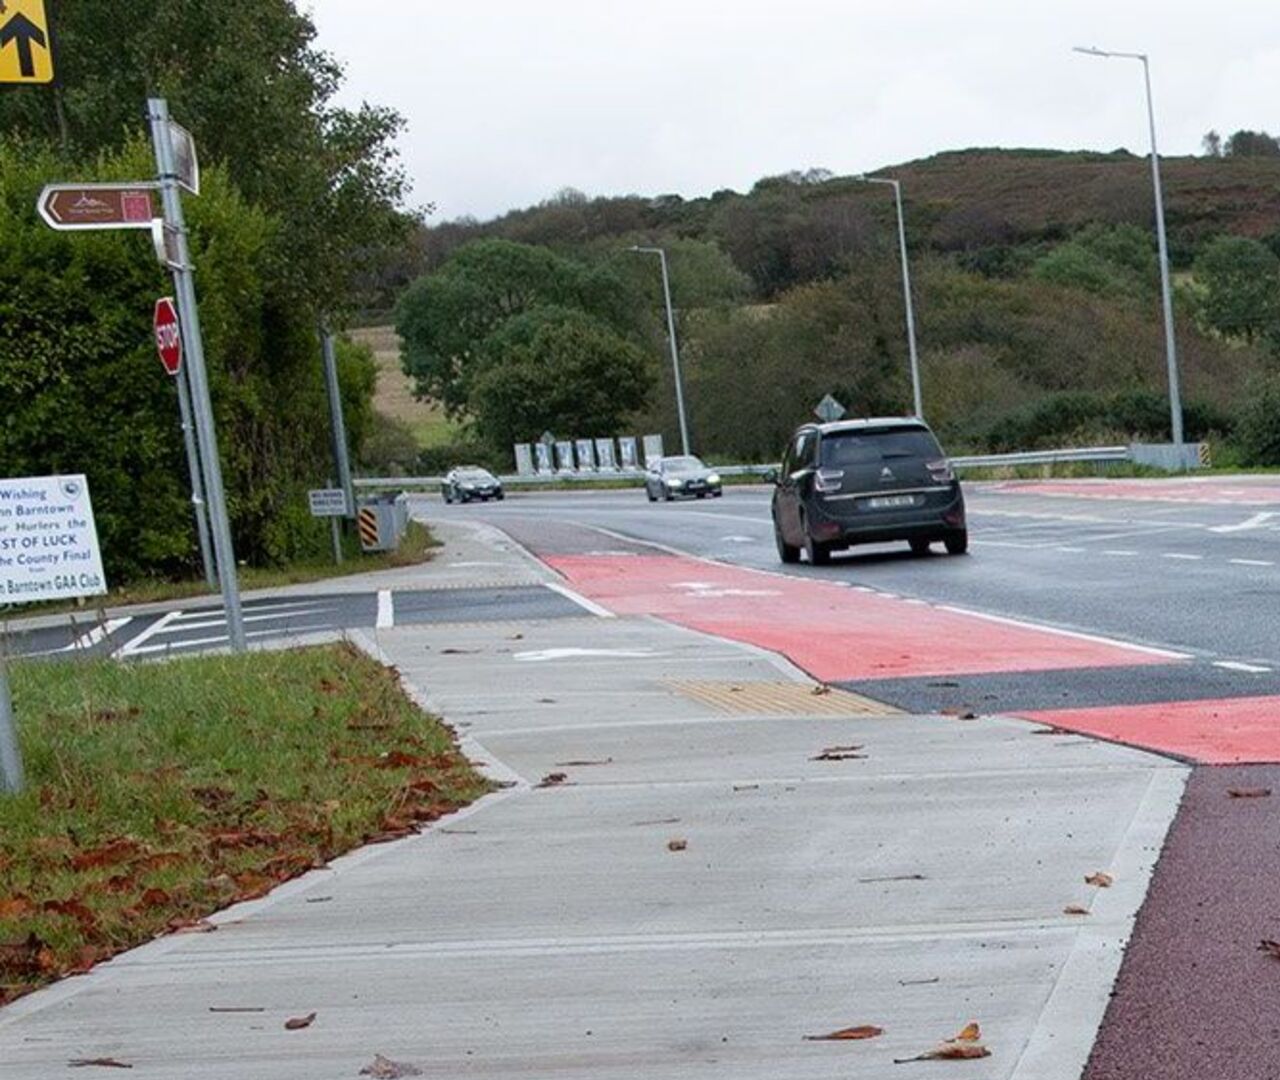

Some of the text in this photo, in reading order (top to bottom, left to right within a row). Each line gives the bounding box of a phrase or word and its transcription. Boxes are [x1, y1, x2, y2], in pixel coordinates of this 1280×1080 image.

[157, 322, 179, 349] STOP
[0, 490, 46, 501] Wishing
[16, 504, 74, 516] Barntown
[16, 521, 60, 532] Hurlers
[67, 518, 87, 528] the
[21, 536, 39, 549] OF
[43, 534, 78, 547] LUCK
[17, 553, 60, 566] County
[63, 549, 92, 561] Final
[54, 575, 77, 590] GAA
[79, 572, 101, 588] Club
